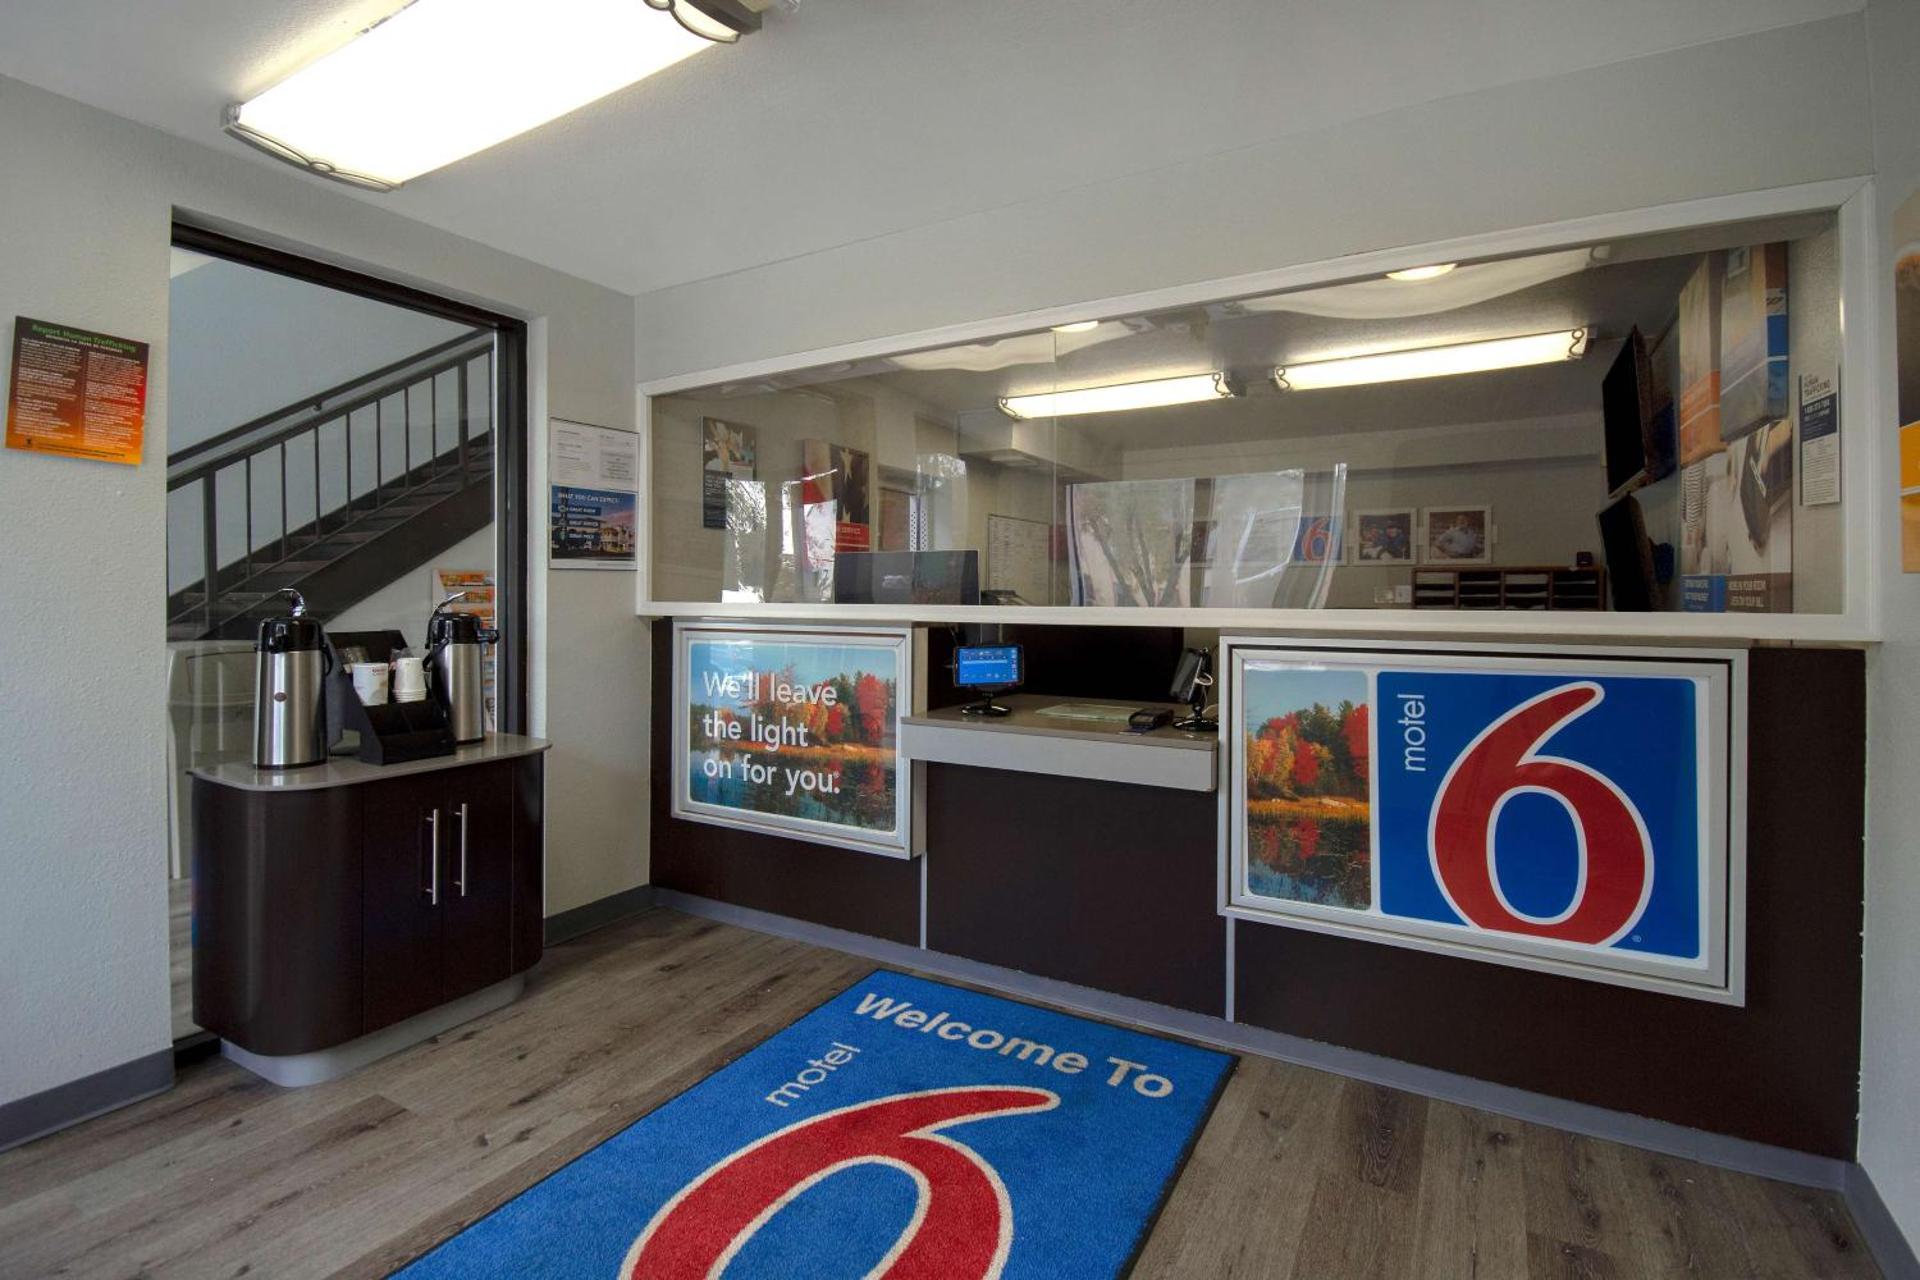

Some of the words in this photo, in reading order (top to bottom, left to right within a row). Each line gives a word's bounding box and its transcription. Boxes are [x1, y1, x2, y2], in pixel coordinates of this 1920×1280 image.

[703, 672, 760, 701] We'll
[769, 672, 838, 707] leave
[703, 710, 742, 740] the
[751, 713, 809, 752] light
[1396, 694, 1426, 772] motel
[703, 757, 732, 779] on
[740, 753, 777, 785] for
[785, 767, 841, 796] you.
[1427, 681, 1655, 949] 6
[763, 1041, 863, 1109] motel
[852, 992, 1089, 1075] Welcome
[1106, 1055, 1175, 1099] To
[616, 1084, 1062, 1280] 6
